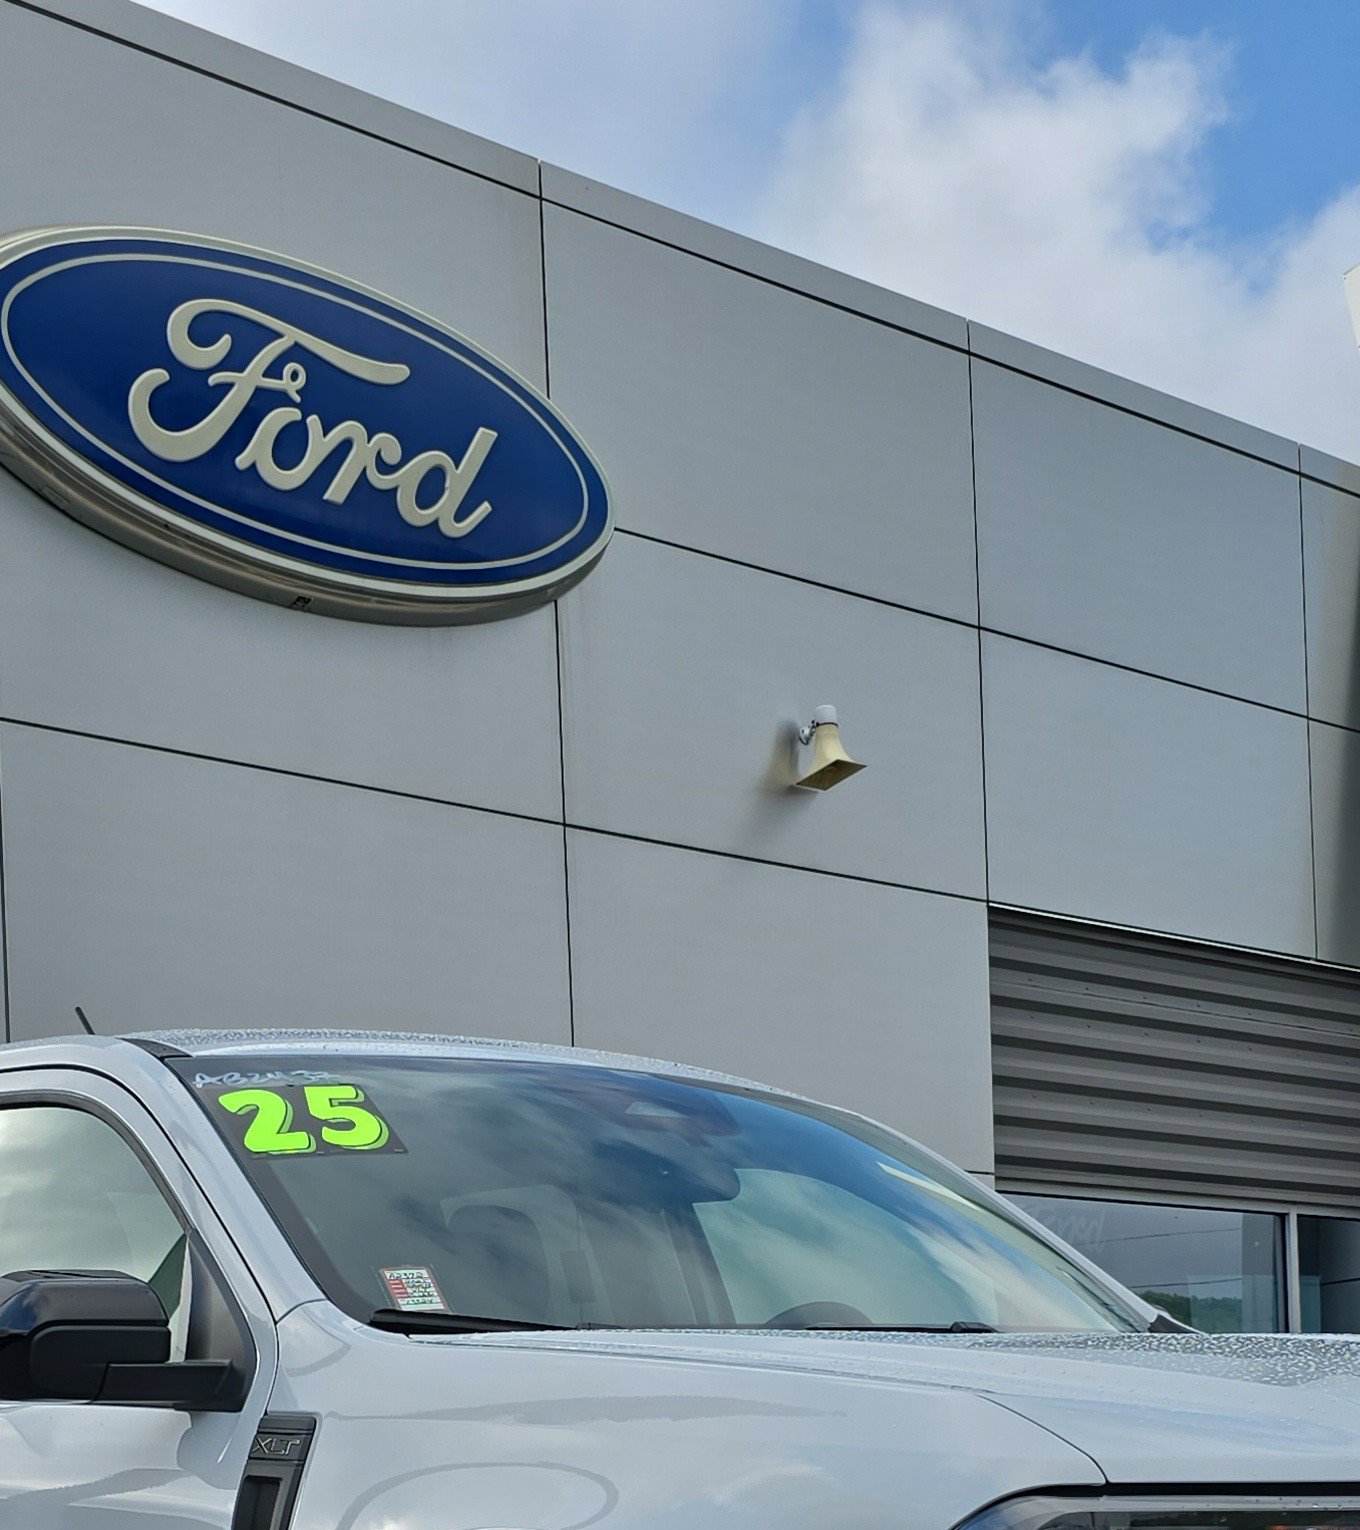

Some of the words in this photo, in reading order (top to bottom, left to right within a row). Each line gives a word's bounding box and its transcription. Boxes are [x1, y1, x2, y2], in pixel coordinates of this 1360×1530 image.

[128, 298, 497, 539] Ford
[218, 1084, 389, 1155] 25
[252, 1437, 300, 1455] XLT
